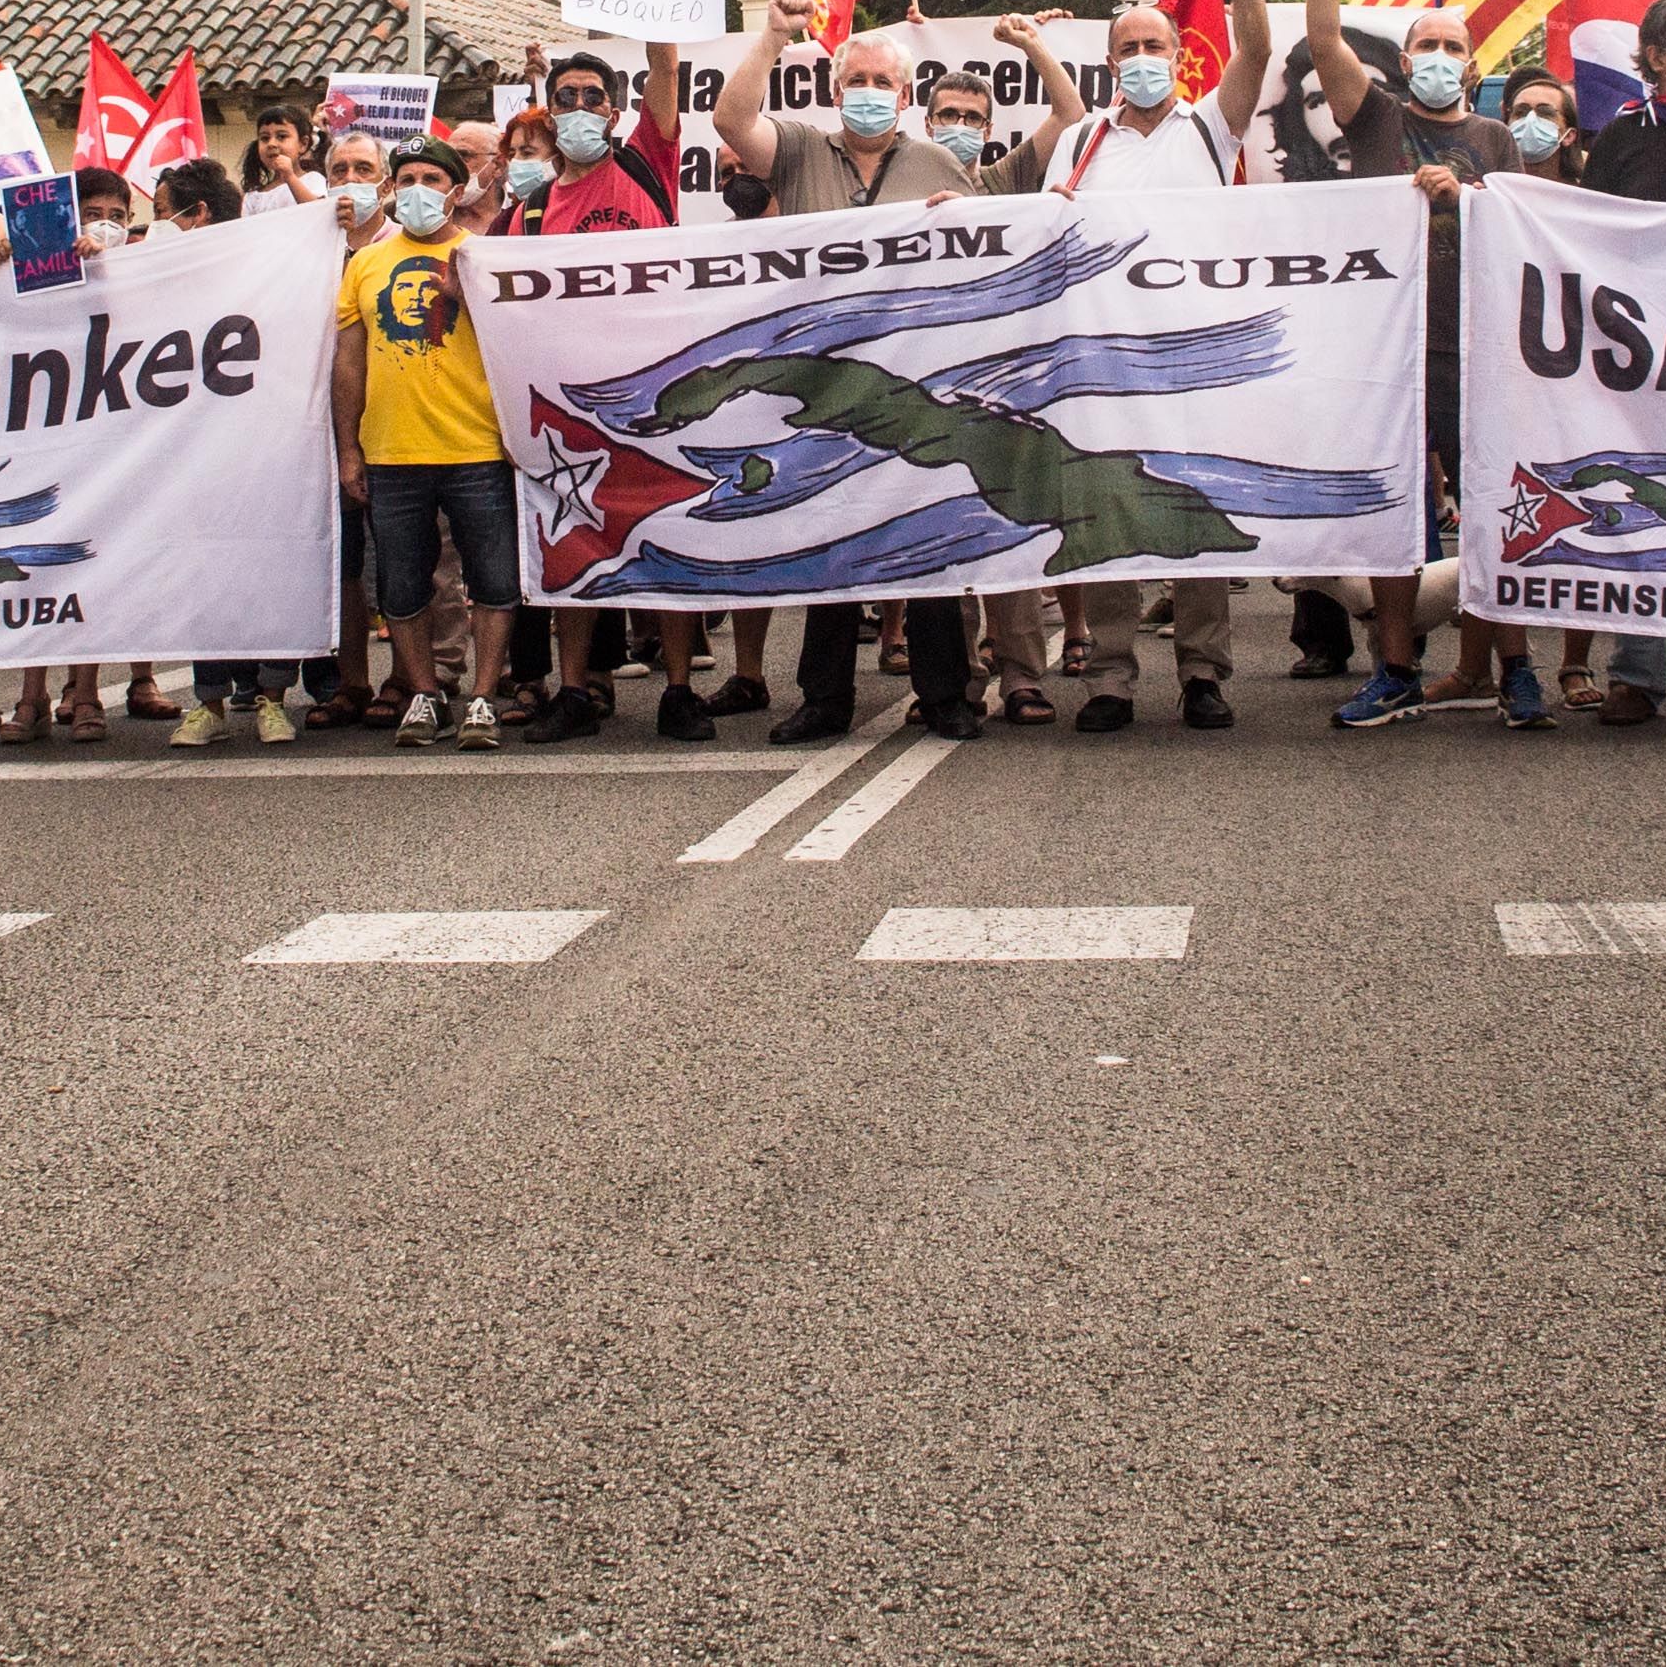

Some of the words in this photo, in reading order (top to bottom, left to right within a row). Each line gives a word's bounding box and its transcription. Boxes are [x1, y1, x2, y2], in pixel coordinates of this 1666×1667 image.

[403, 107, 426, 121] CUBA
[14, 181, 58, 207] CHE
[489, 223, 1014, 304] DEFENSEM
[1126, 247, 1398, 290] CUBA
